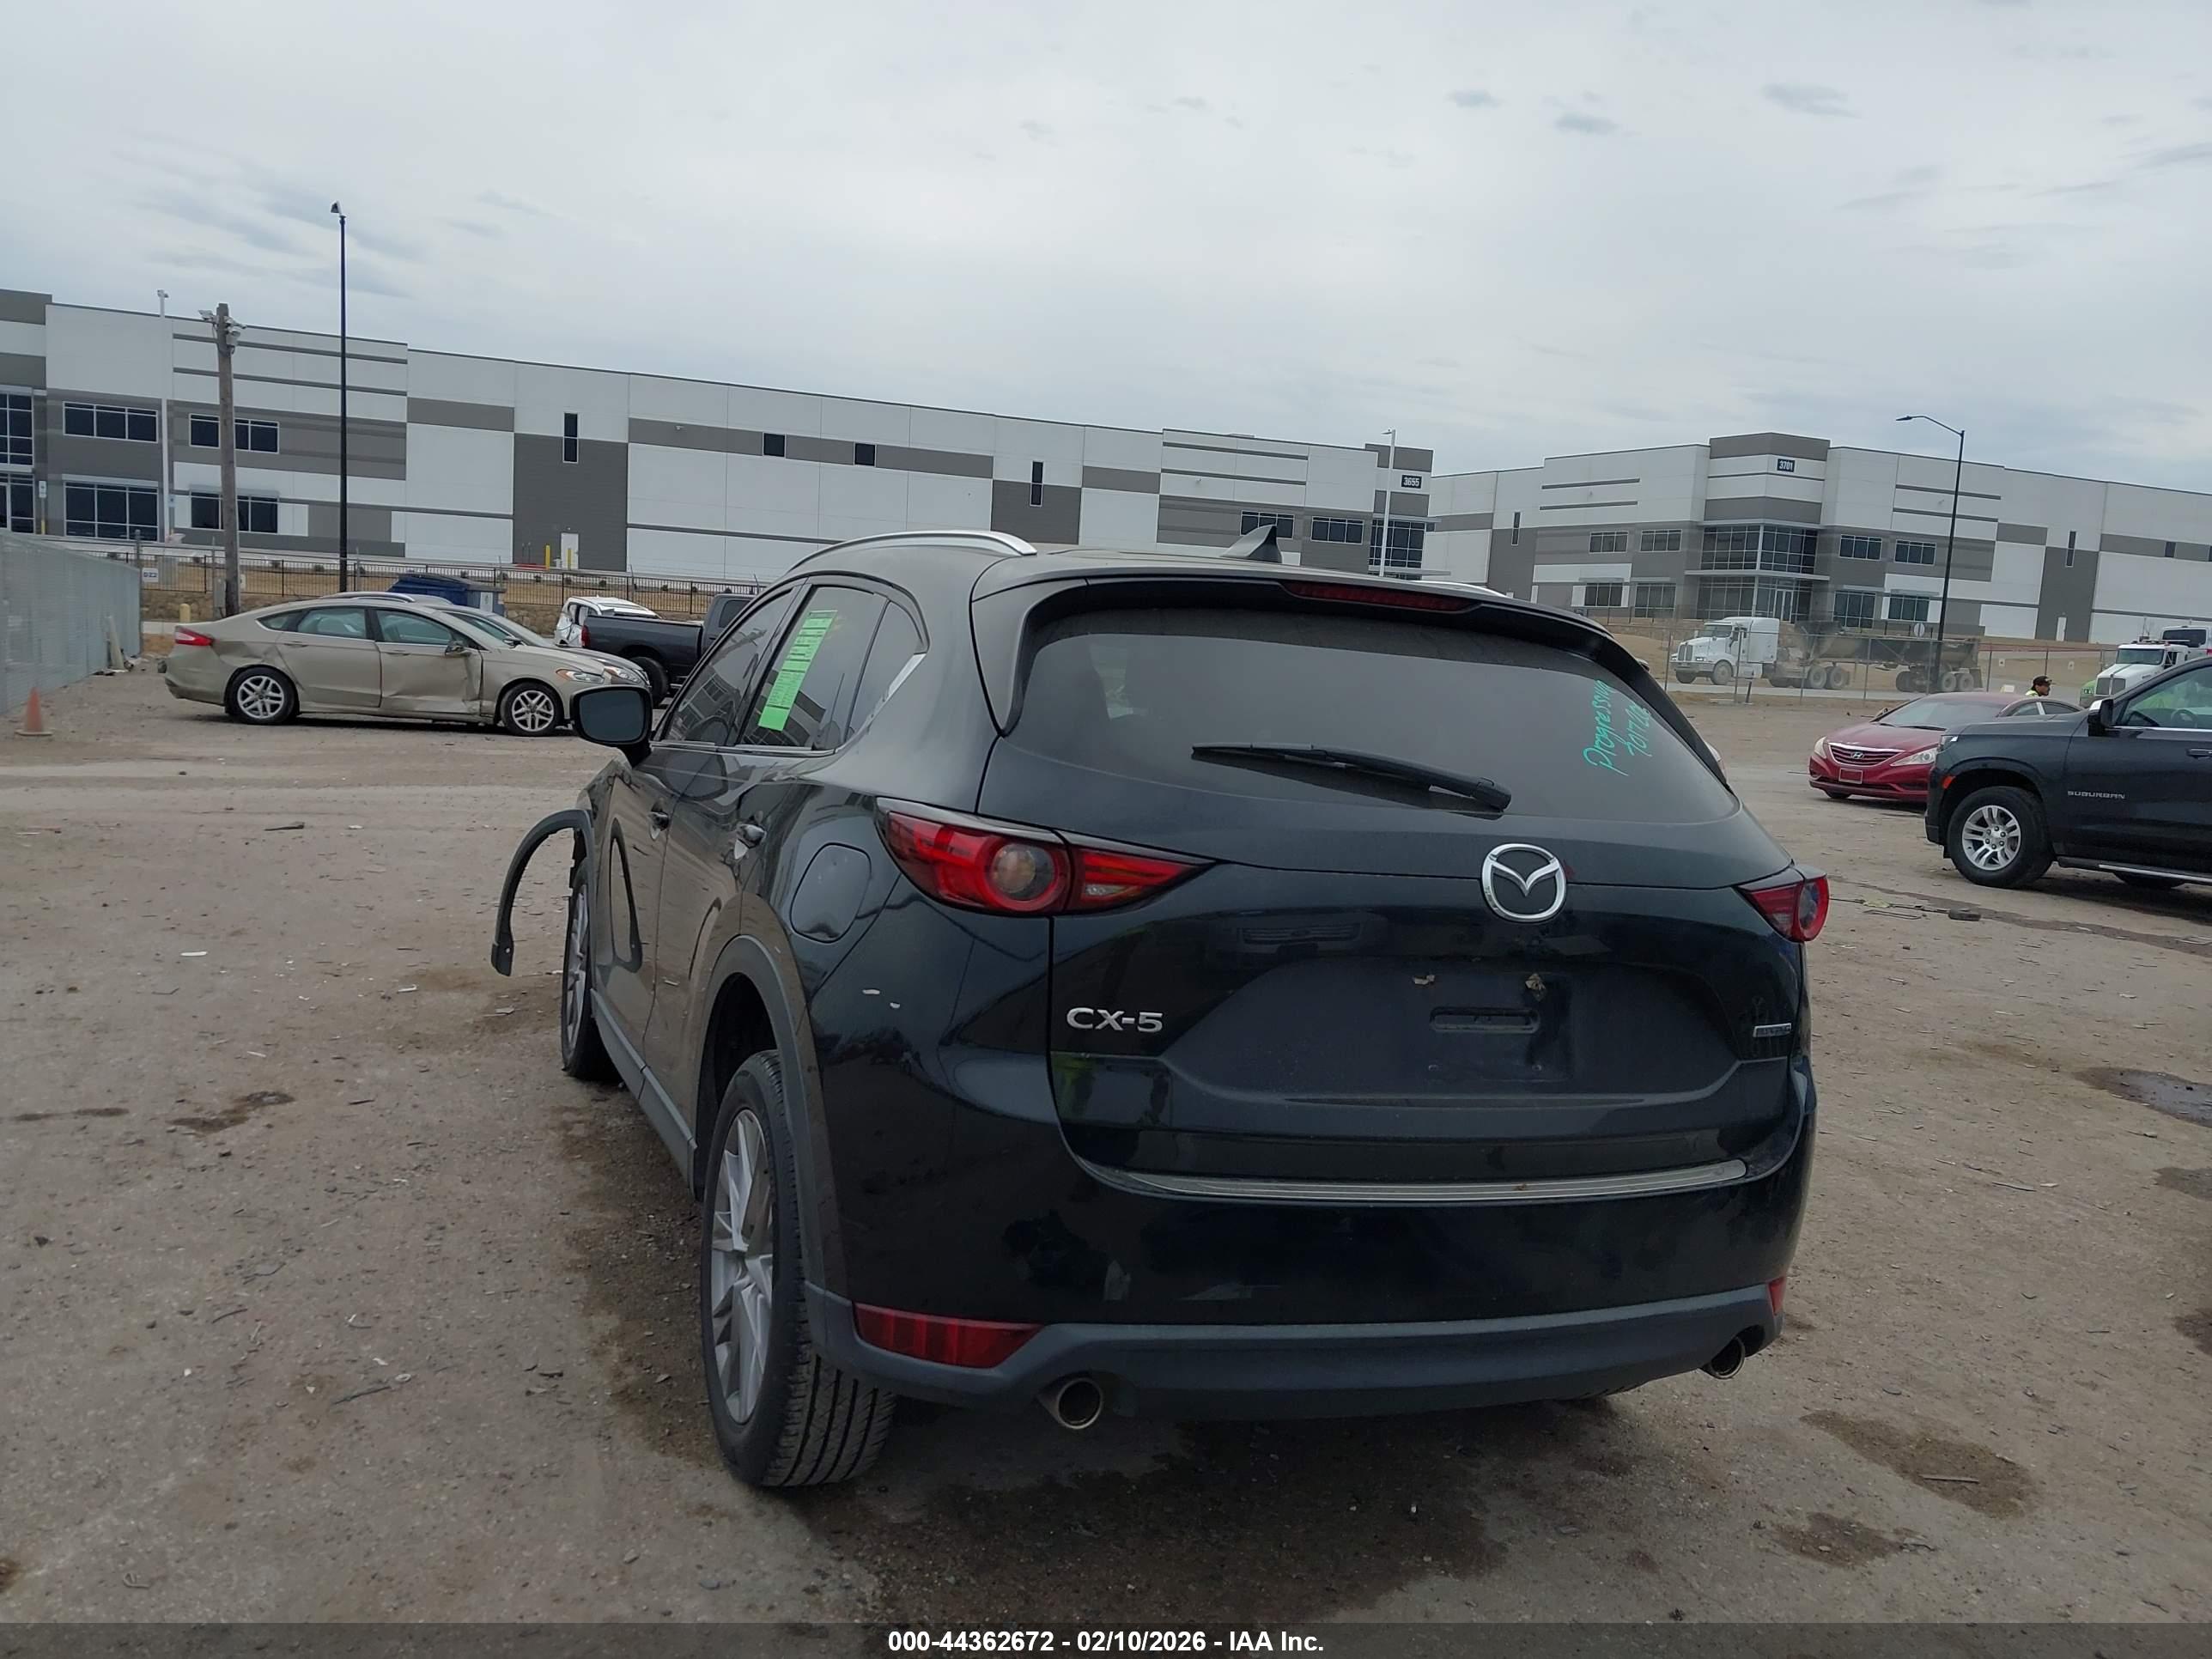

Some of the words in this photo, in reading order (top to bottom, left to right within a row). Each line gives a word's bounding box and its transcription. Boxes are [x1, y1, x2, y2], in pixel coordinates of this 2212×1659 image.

[1778, 460, 1794, 471] 3701
[1403, 477, 1420, 487] 3655
[2067, 790, 2126, 799] SUBURBAN
[1066, 1006, 1164, 1033] CX-5
